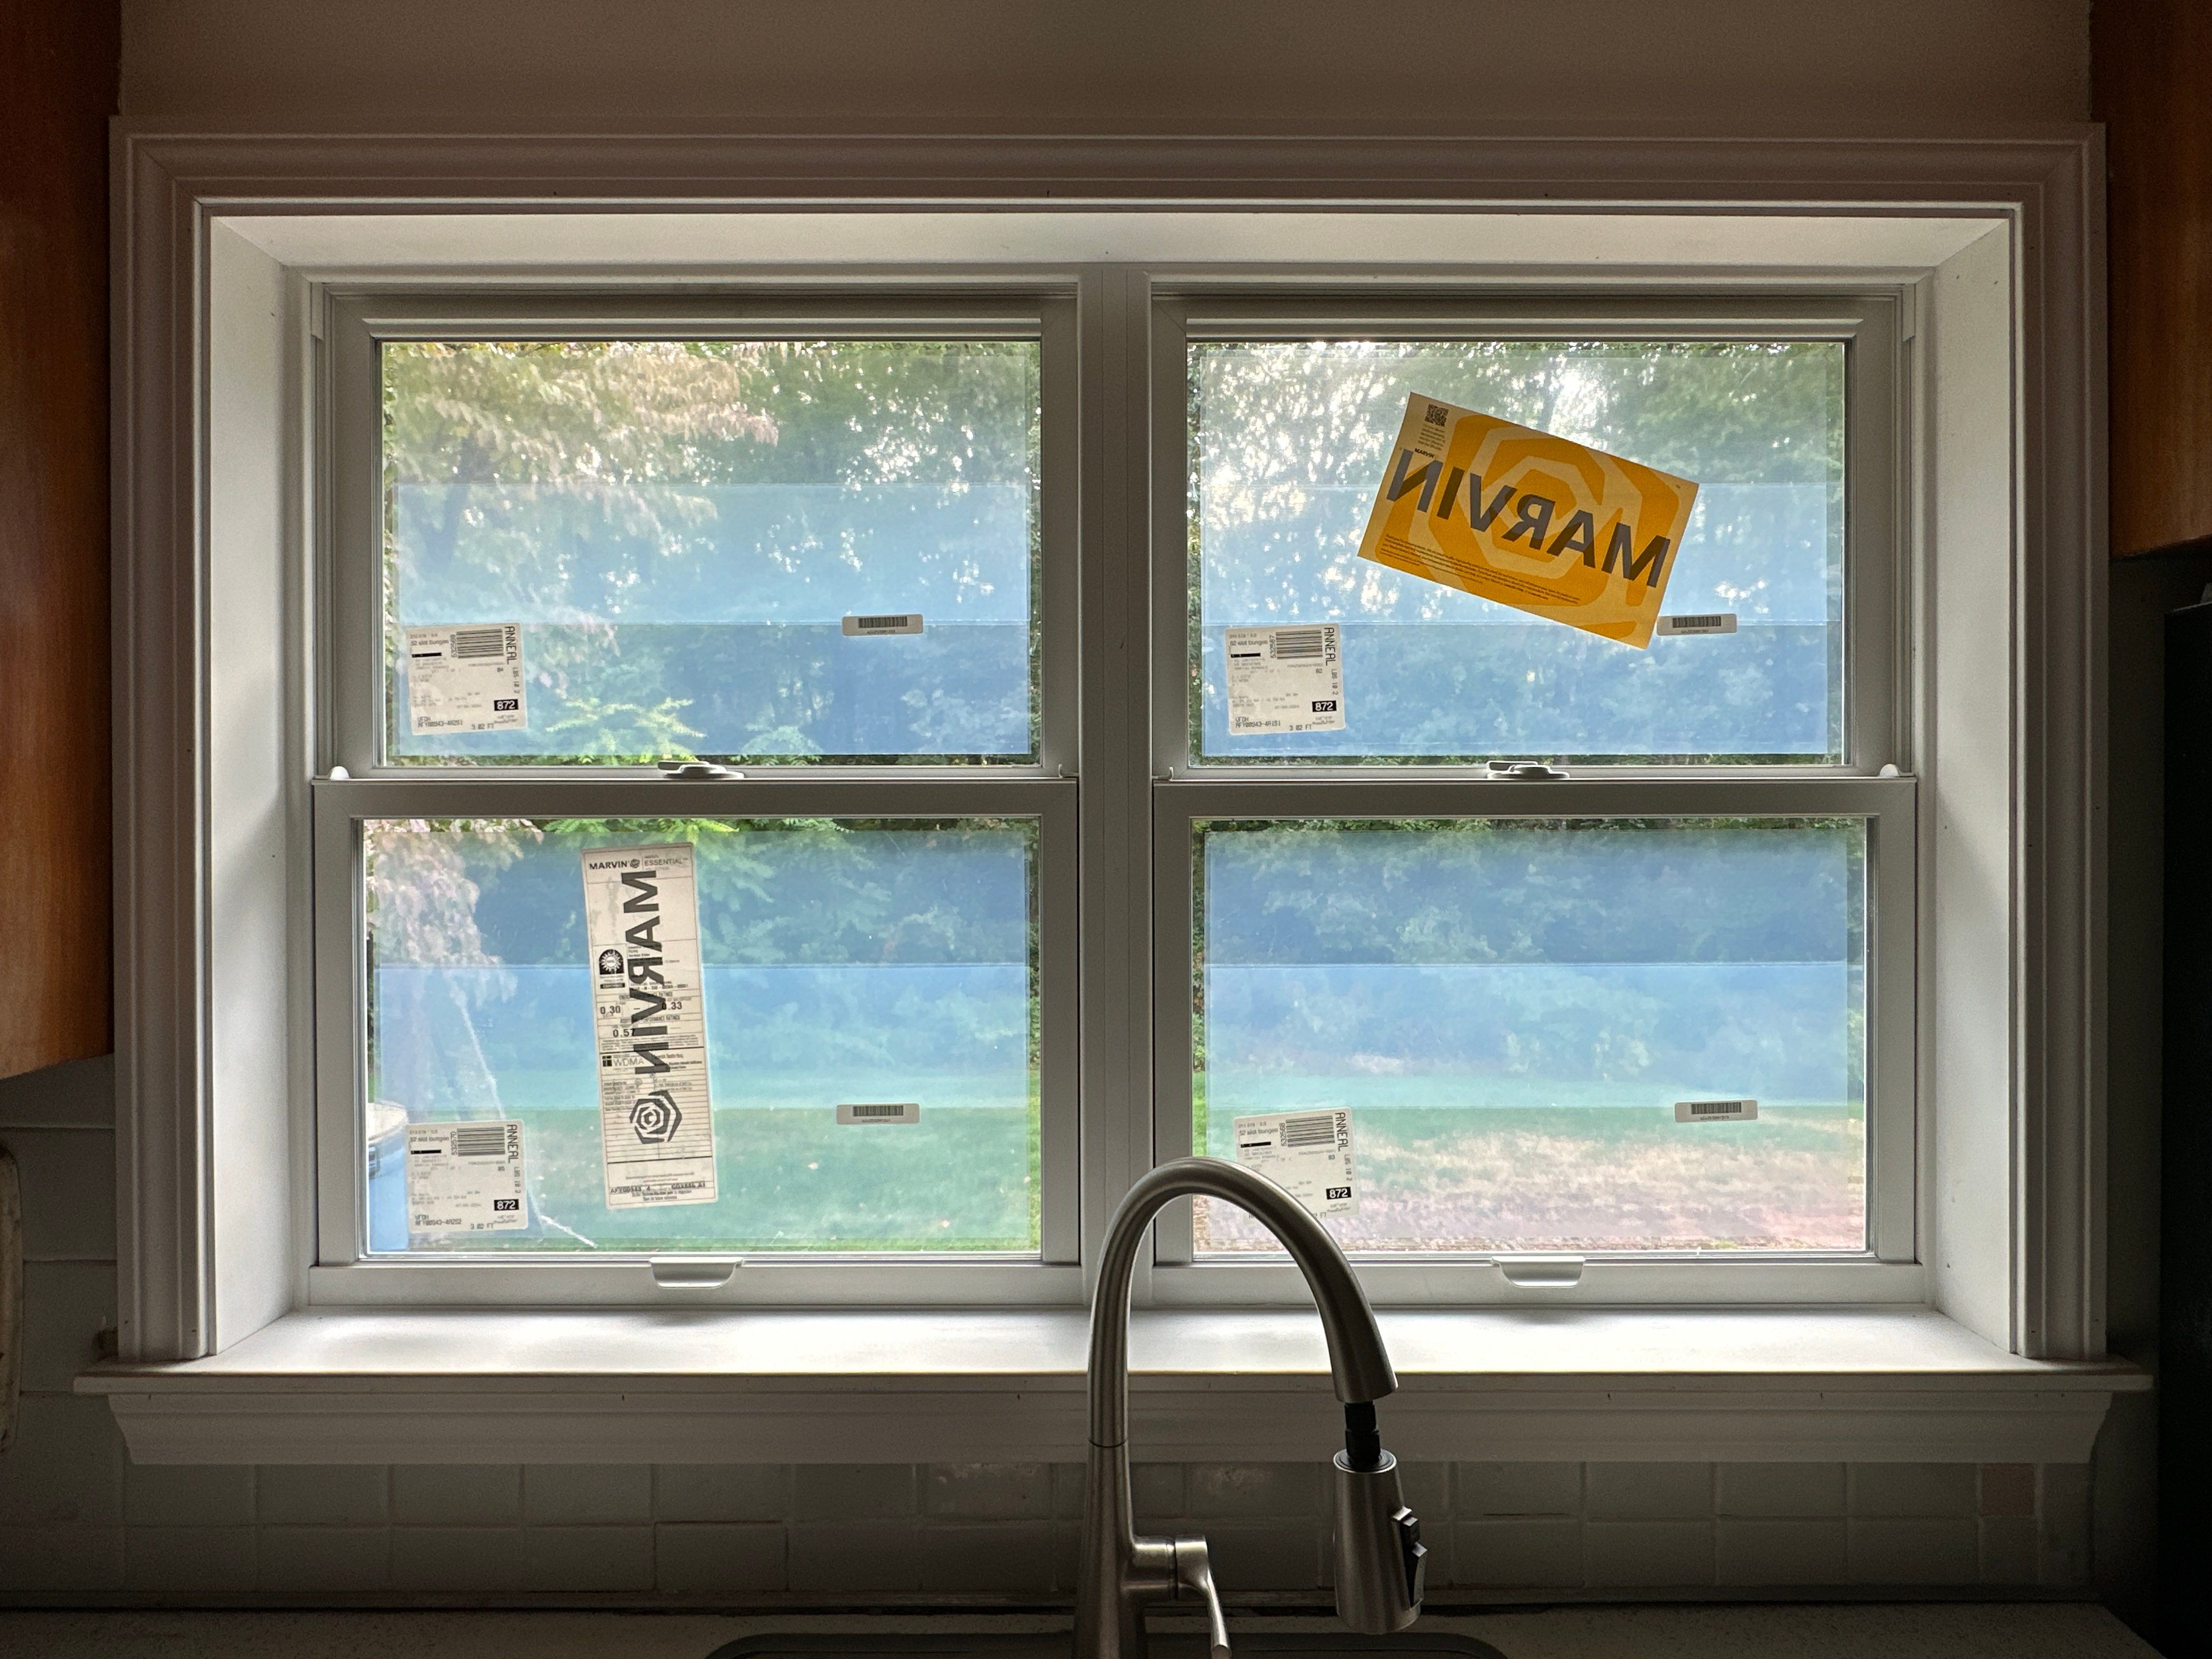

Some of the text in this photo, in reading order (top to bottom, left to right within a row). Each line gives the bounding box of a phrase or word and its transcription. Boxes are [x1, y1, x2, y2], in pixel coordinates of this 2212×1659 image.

[504, 626, 517, 664] ANNEAL
[1324, 627, 1336, 666] ANNEAL
[496, 701, 515, 710] 872
[1315, 702, 1334, 711] 872
[589, 860, 628, 870] MARVIN
[600, 1006, 620, 1014] 0.30
[662, 1002, 682, 1011] 0.33
[614, 1057, 645, 1066] WDMA
[1335, 1112, 1349, 1152] ANNEAL
[507, 1125, 519, 1163] ANNEAL
[1329, 1189, 1348, 1198] 872
[496, 1201, 516, 1210] 872
